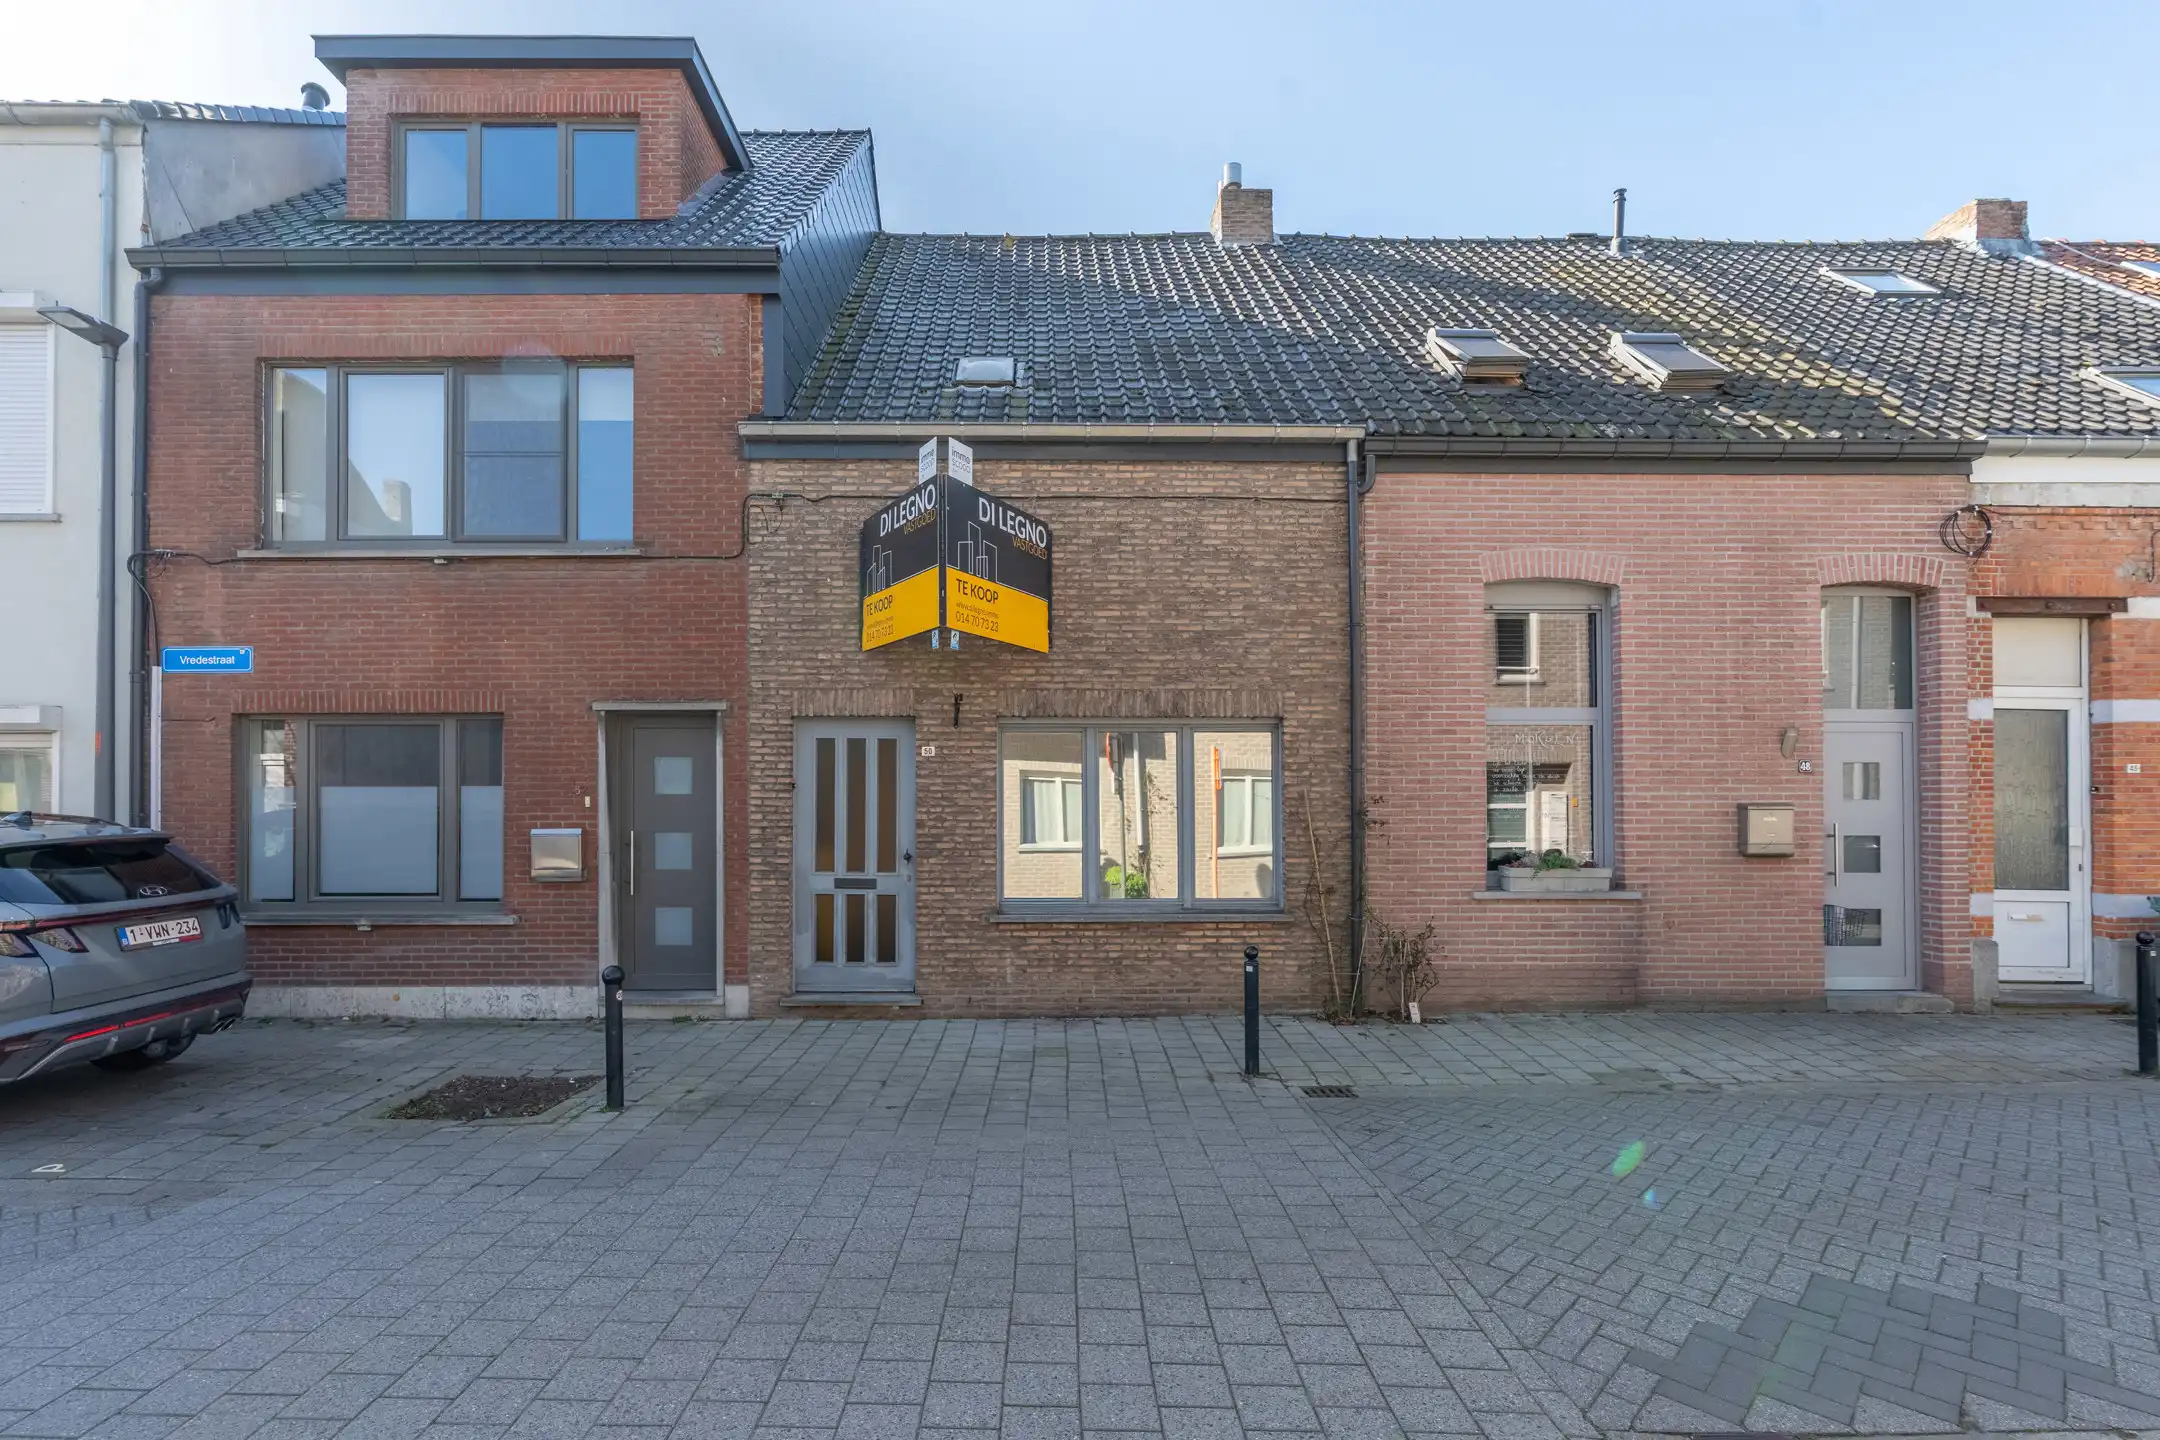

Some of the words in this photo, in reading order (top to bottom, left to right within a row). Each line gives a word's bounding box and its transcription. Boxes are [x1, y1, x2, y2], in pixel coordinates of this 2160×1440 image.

[880, 509, 892, 537] DI
[893, 484, 936, 529] LEGNO
[903, 508, 937, 535] VASTGOED
[978, 496, 996, 526] DI
[999, 506, 1047, 548] LEGNO
[1011, 535, 1049, 560] VASTGOED
[956, 578, 969, 596] TE
[970, 583, 999, 604] KOOP
[866, 602, 873, 616] TE
[874, 594, 894, 614] KOOP
[955, 610, 970, 624] 014
[970, 614, 980, 627] 70
[980, 617, 990, 630] 73
[990, 620, 999, 632] 23
[179, 655, 236, 665] Vredestraat
[924, 747, 933, 755] 50
[1800, 761, 1811, 771] 48
